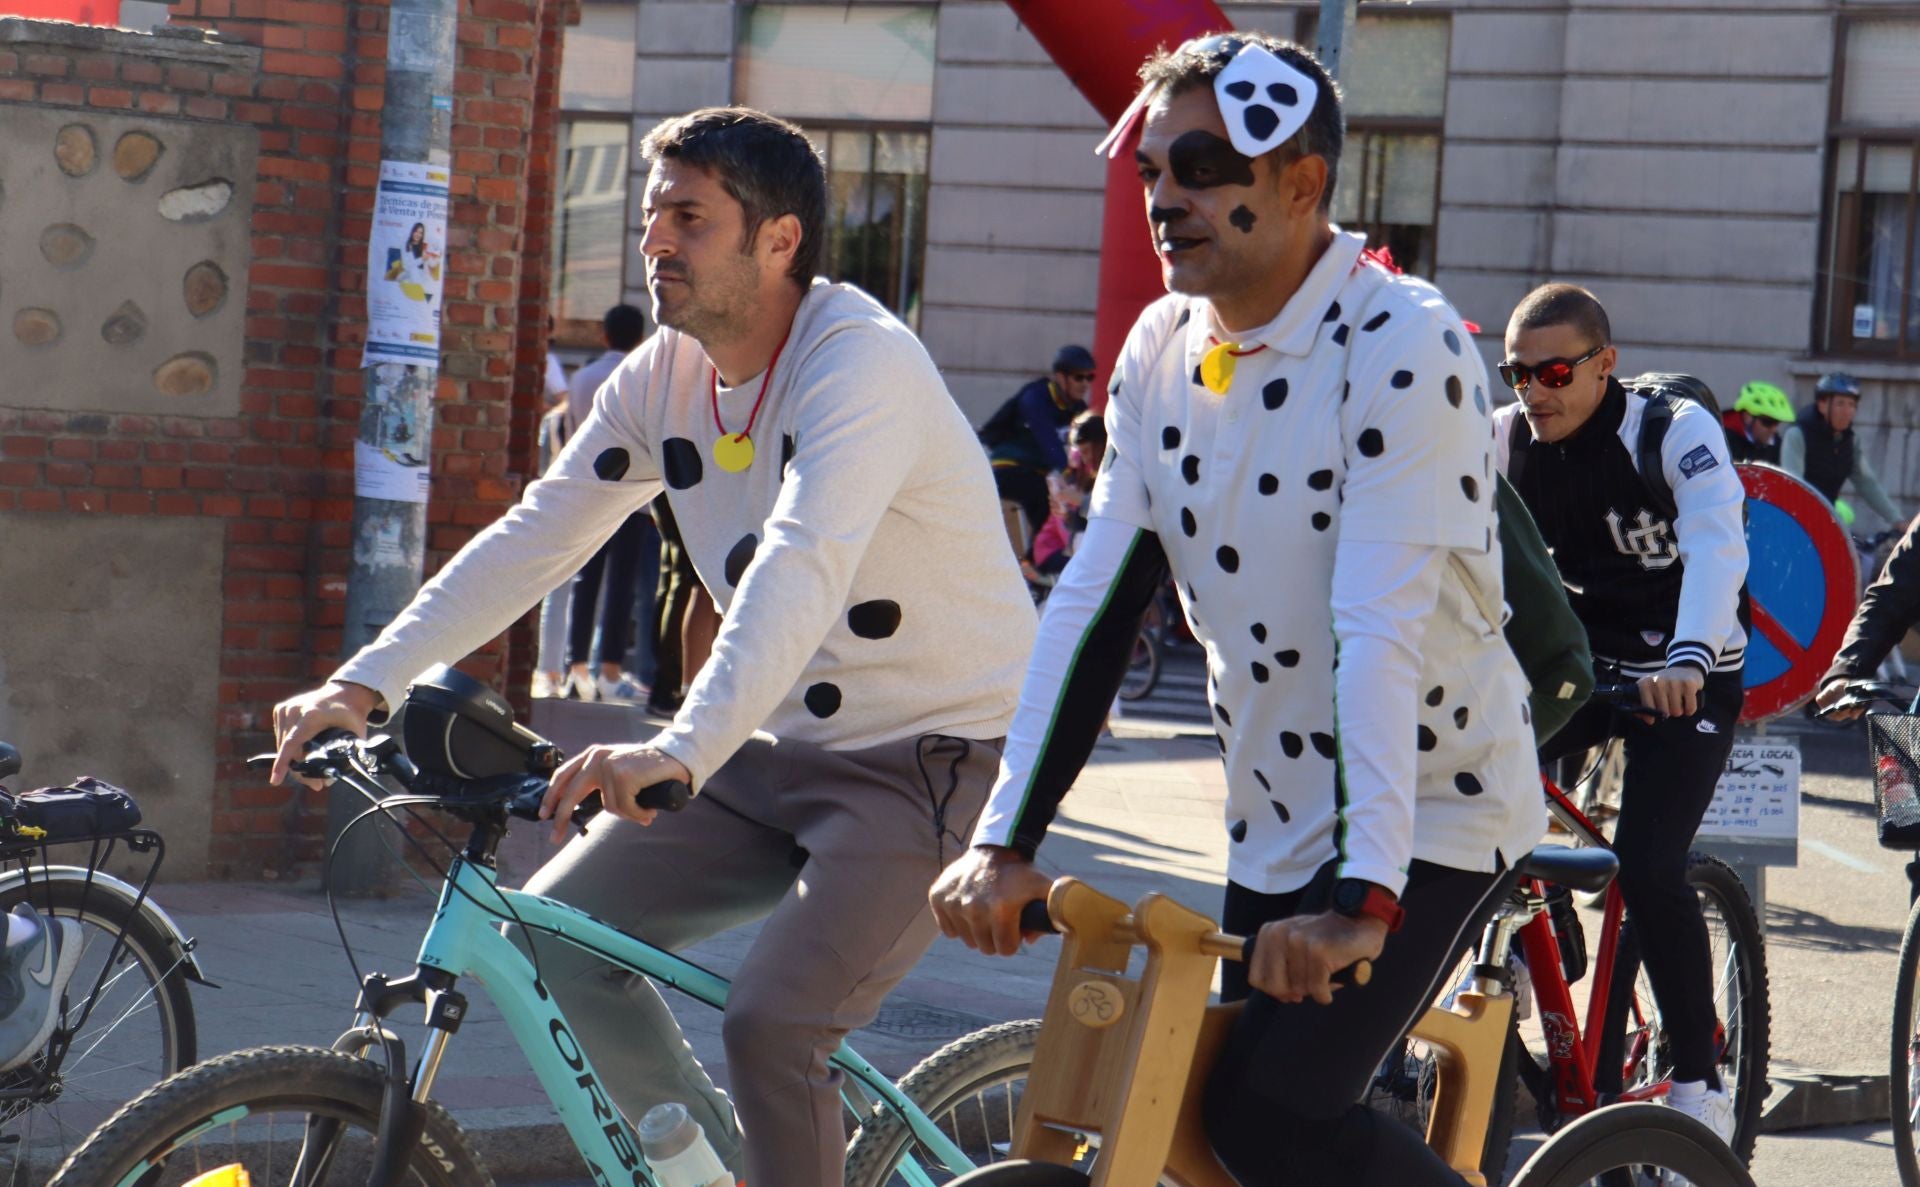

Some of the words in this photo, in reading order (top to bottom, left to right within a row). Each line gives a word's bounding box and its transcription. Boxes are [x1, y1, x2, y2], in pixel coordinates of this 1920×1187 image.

[388, 206, 416, 217] Venta
[1699, 719, 1717, 732] NIKE
[1729, 749, 1754, 759] ICIA
[1760, 750, 1795, 760] LOCAL
[420, 1131, 455, 1174] NDA
